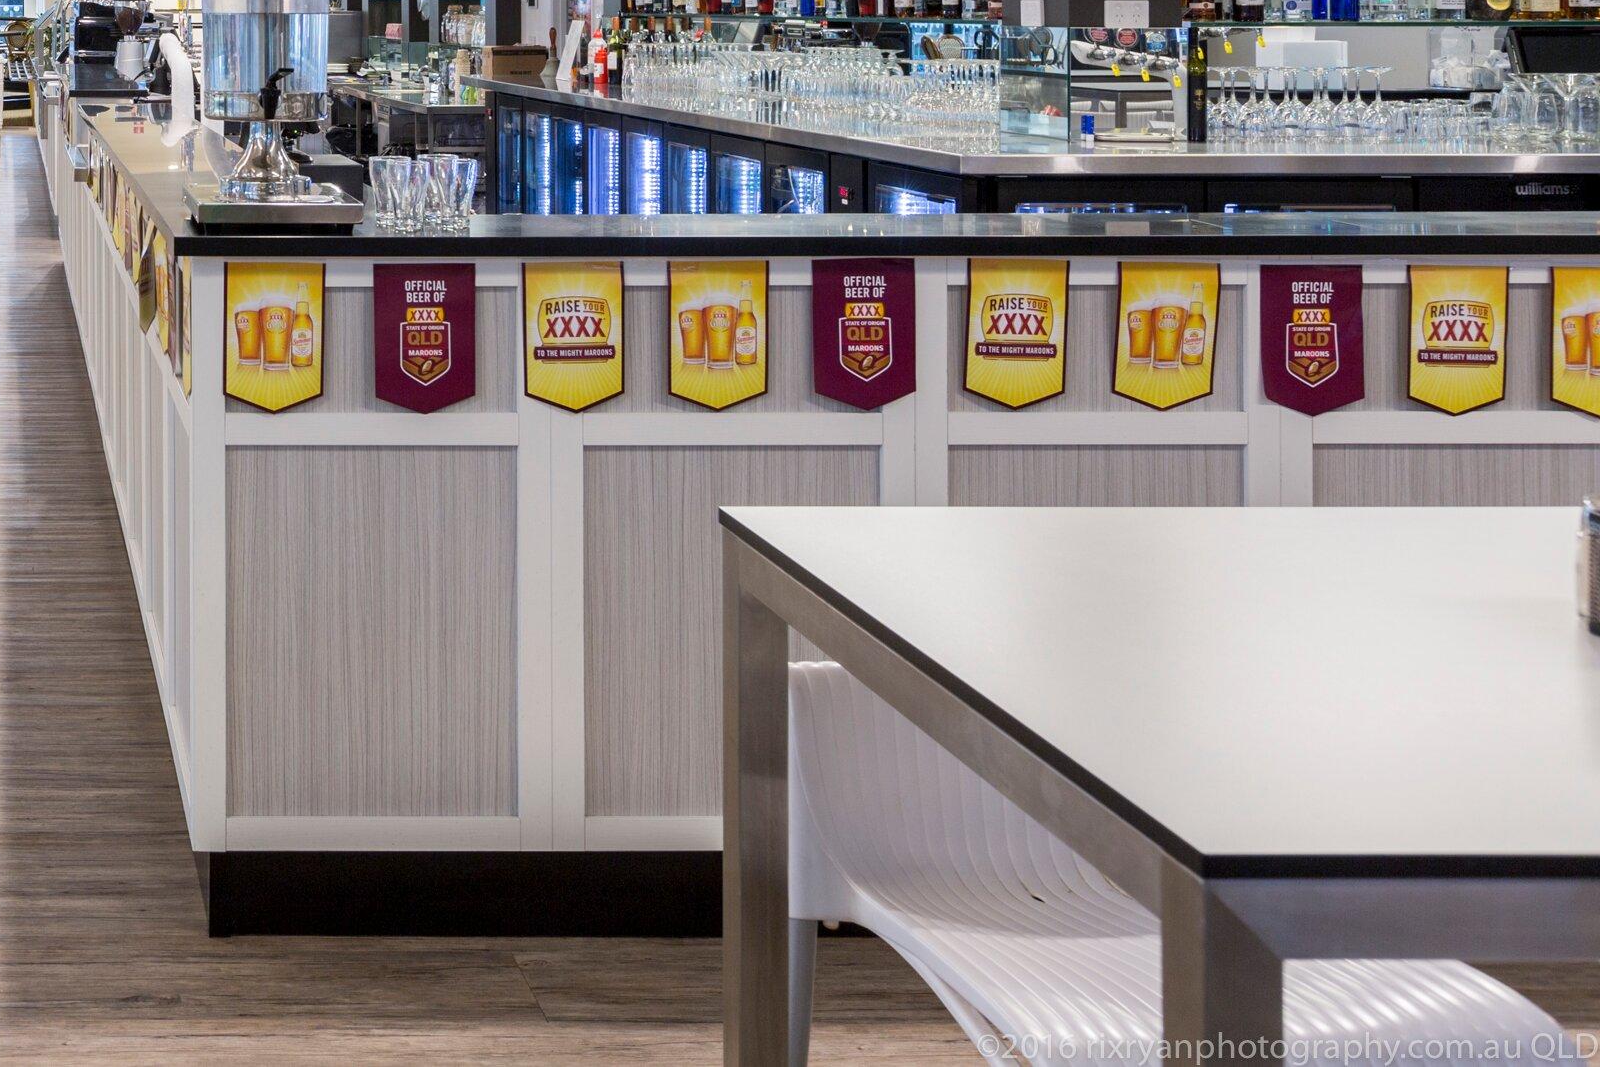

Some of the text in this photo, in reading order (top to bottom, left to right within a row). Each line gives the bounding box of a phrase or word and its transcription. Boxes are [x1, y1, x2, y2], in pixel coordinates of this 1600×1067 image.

[404, 280, 447, 291] OFFICIAL
[843, 276, 887, 286] OFFICIAL
[845, 287, 885, 298] BEER OF
[1291, 282, 1334, 293] OFFICIAL
[406, 292, 445, 303] BEER OF
[1293, 293, 1332, 304] BEER OF
[545, 300, 605, 315] RAISE YOUR
[989, 297, 1048, 311] RAISE YOUR
[411, 310, 441, 321] XXXX
[849, 305, 882, 317] XXXX
[1297, 311, 1327, 322] XXXX
[1430, 304, 1489, 318] RAISE YOUR
[543, 316, 606, 338] XXXX
[986, 313, 1048, 335] XXXX
[846, 326, 883, 341] QLD
[1427, 320, 1489, 342] XXXX
[408, 331, 443, 346] QLD
[1293, 332, 1329, 347] QLD
[537, 348, 613, 357] TO THE MIGHTY MAROONS
[979, 345, 986, 353] TO
[1001, 346, 1024, 354] MIGHTY
[1294, 350, 1329, 358] MAROONS
[1430, 352, 1441, 360] THE
